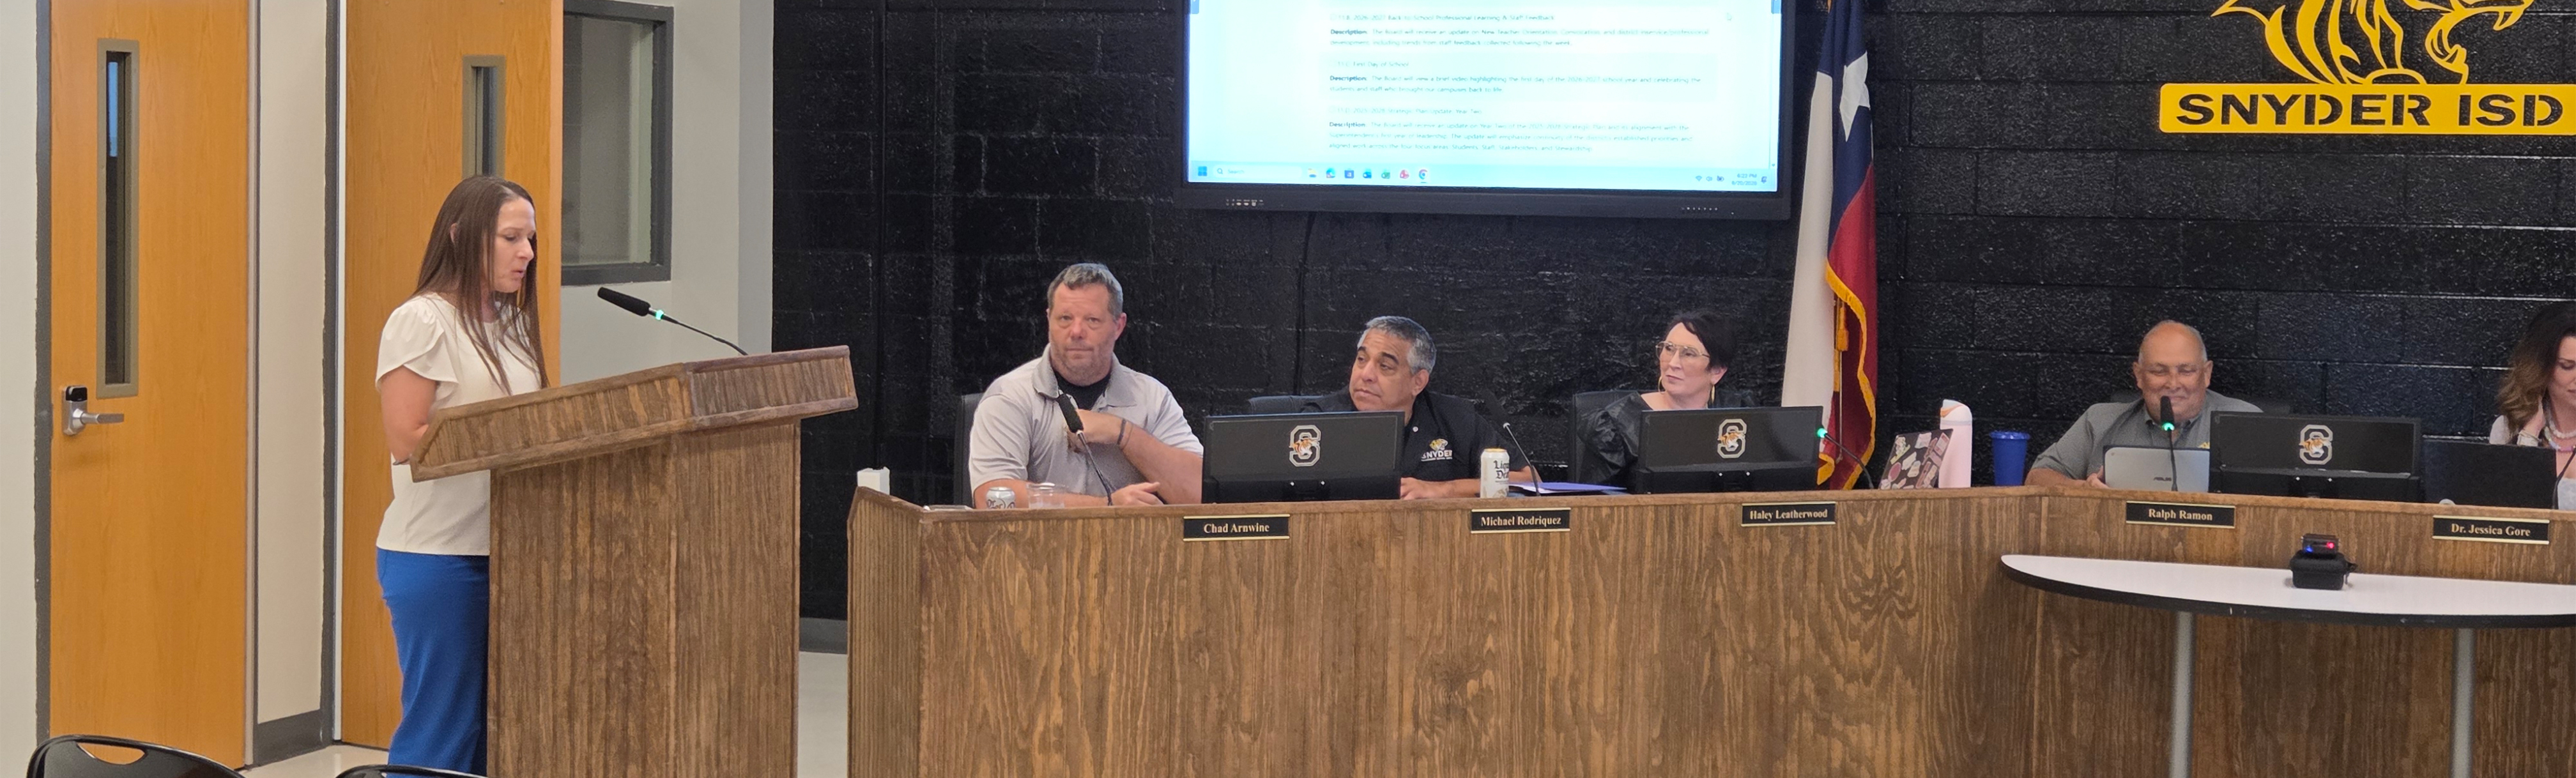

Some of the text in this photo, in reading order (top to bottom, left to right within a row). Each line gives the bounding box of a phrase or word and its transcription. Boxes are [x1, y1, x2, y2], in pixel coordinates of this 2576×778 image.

[2176, 93, 2563, 126] SNYDER ISD
[1750, 509, 1828, 521] Haley Leatherwood
[2149, 508, 2212, 521] Ralph Ramon
[1481, 516, 1515, 526] Michael
[1204, 522, 1269, 533] Chad Arnwine
[2451, 523, 2531, 537] Dr. Jessica Gore
